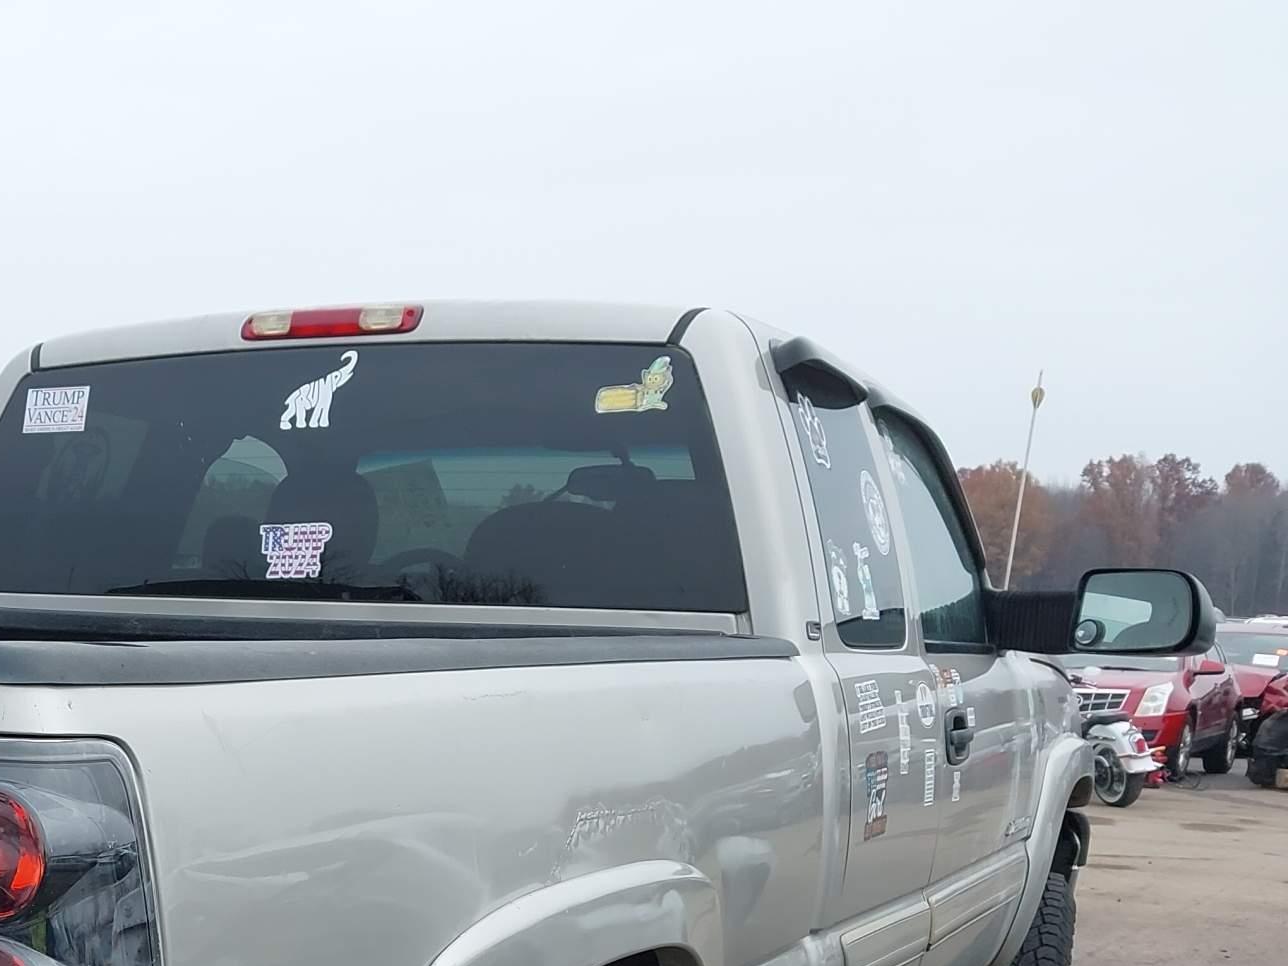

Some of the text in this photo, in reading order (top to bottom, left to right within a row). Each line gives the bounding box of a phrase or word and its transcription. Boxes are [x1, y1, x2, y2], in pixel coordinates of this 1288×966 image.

[31, 389, 85, 407] TRUMP
[27, 407, 69, 424] VANCE
[268, 550, 319, 577] 2024
